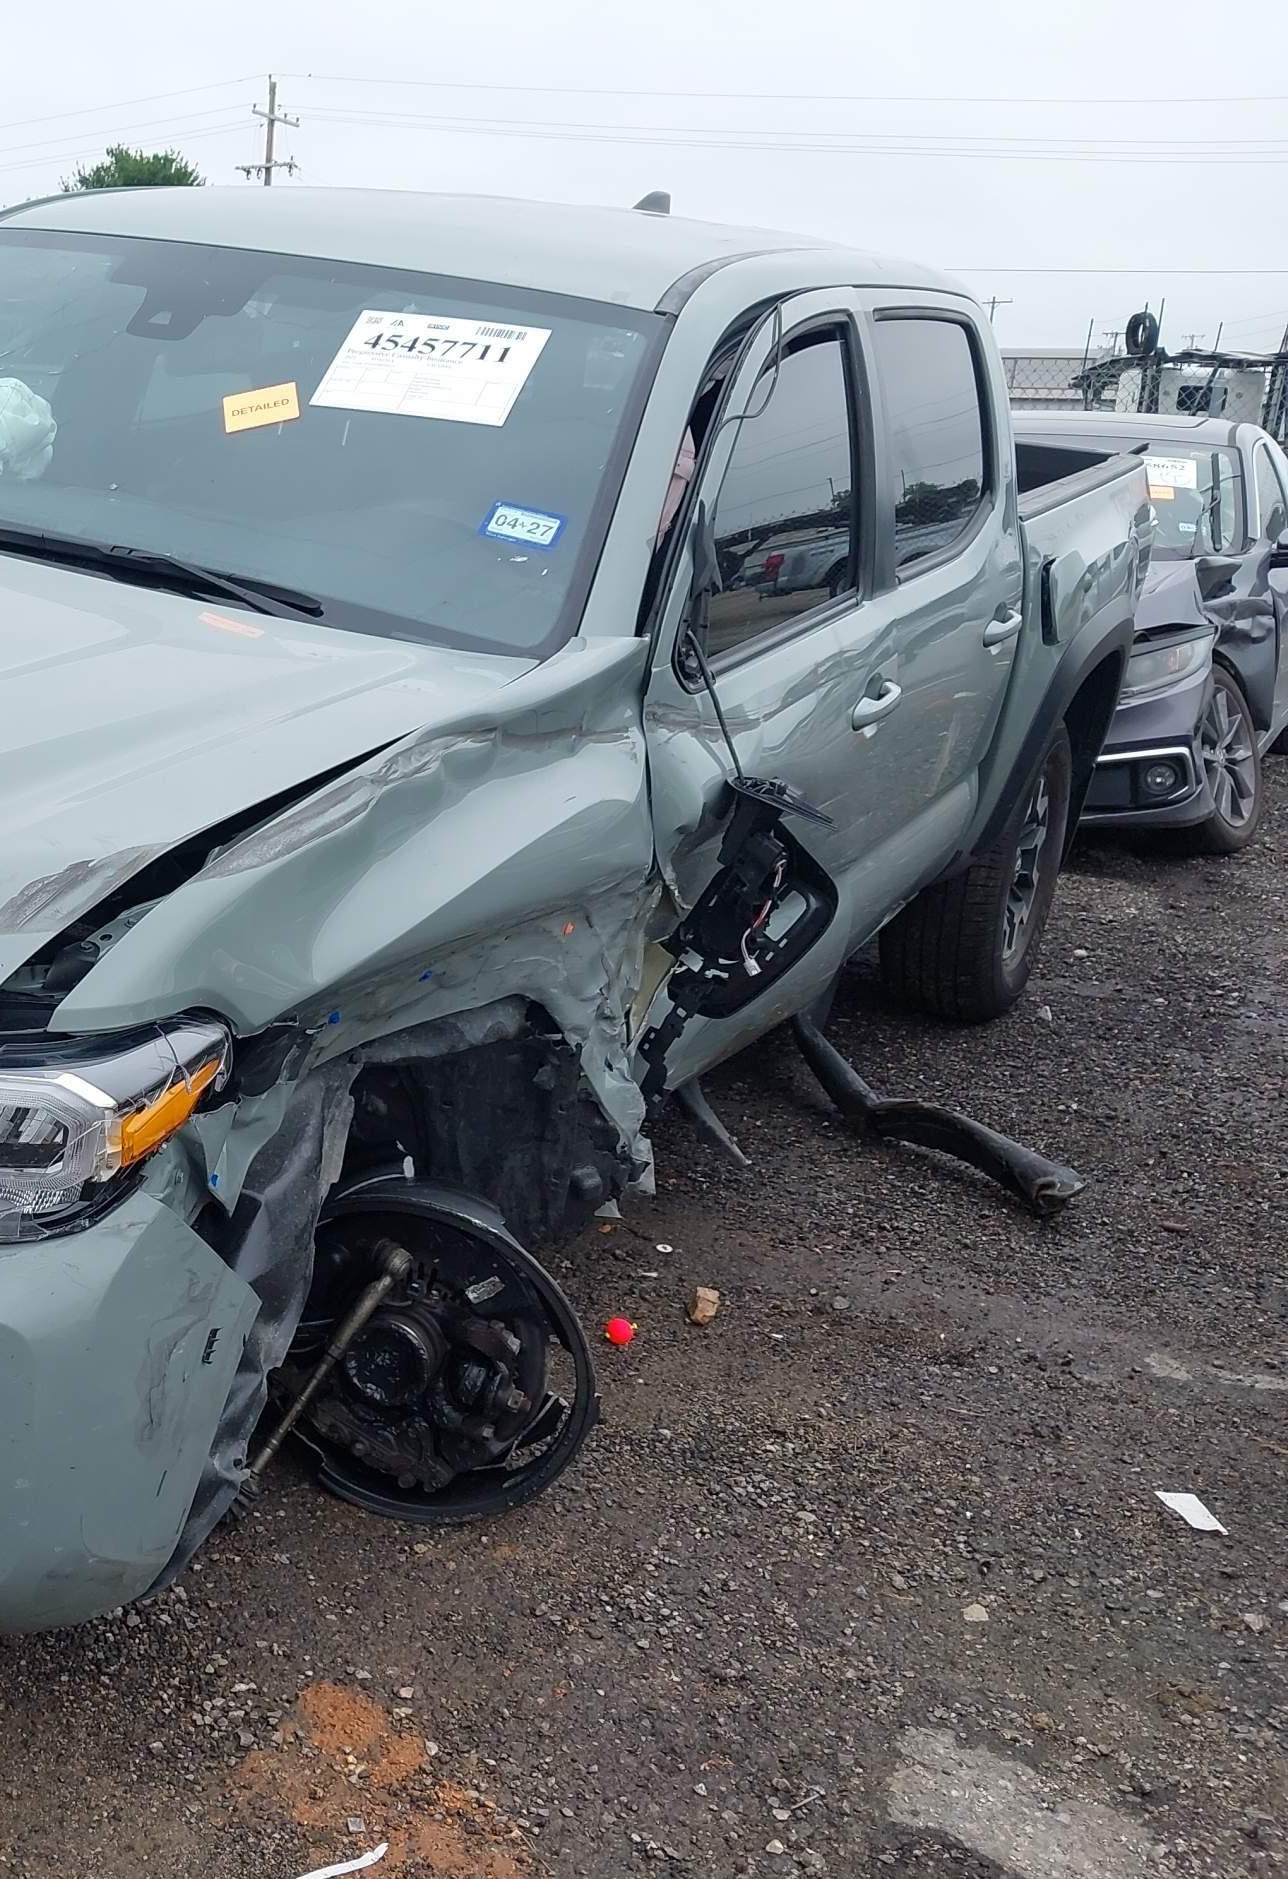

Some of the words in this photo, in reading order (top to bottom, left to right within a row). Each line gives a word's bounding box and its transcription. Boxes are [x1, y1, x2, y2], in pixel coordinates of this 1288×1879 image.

[363, 332, 512, 363] 45457711
[231, 398, 290, 417] DETAILED
[526, 521, 555, 537] 27
